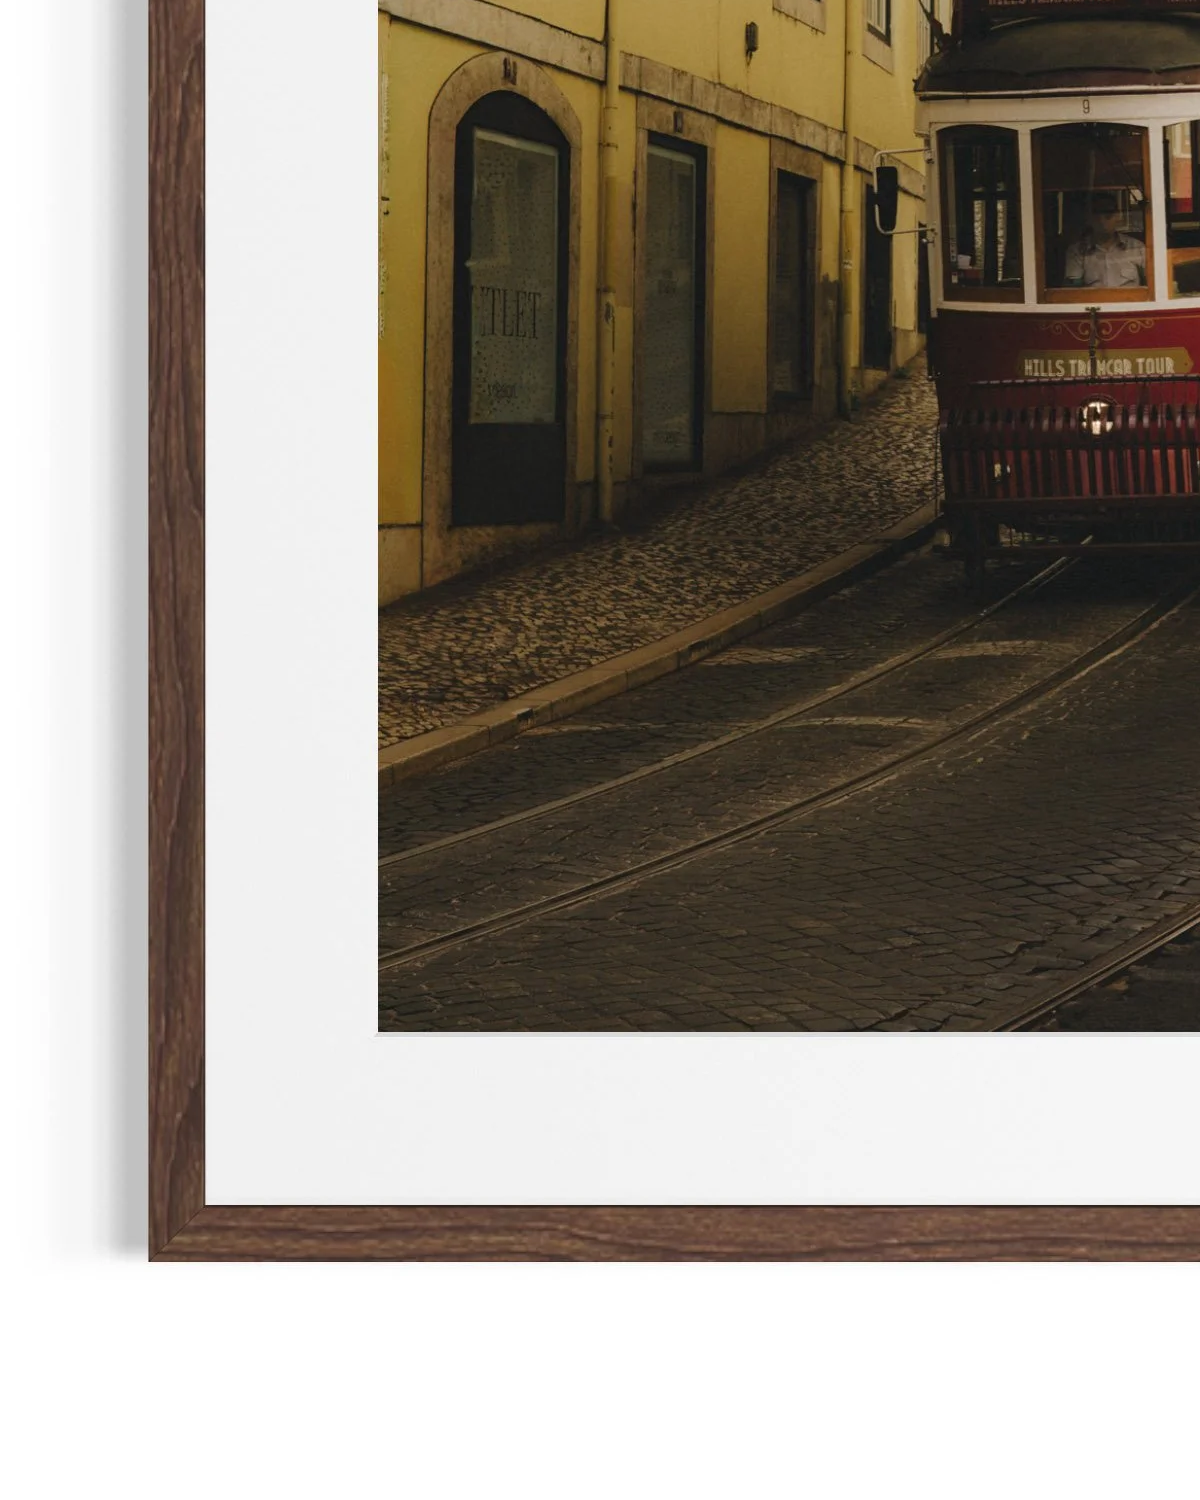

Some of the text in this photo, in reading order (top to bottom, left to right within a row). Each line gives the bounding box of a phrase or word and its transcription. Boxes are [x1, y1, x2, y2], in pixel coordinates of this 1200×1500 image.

[1082, 99, 1090, 114] 9
[1024, 358, 1066, 377] HILLS
[1135, 356, 1176, 376] TOUR
